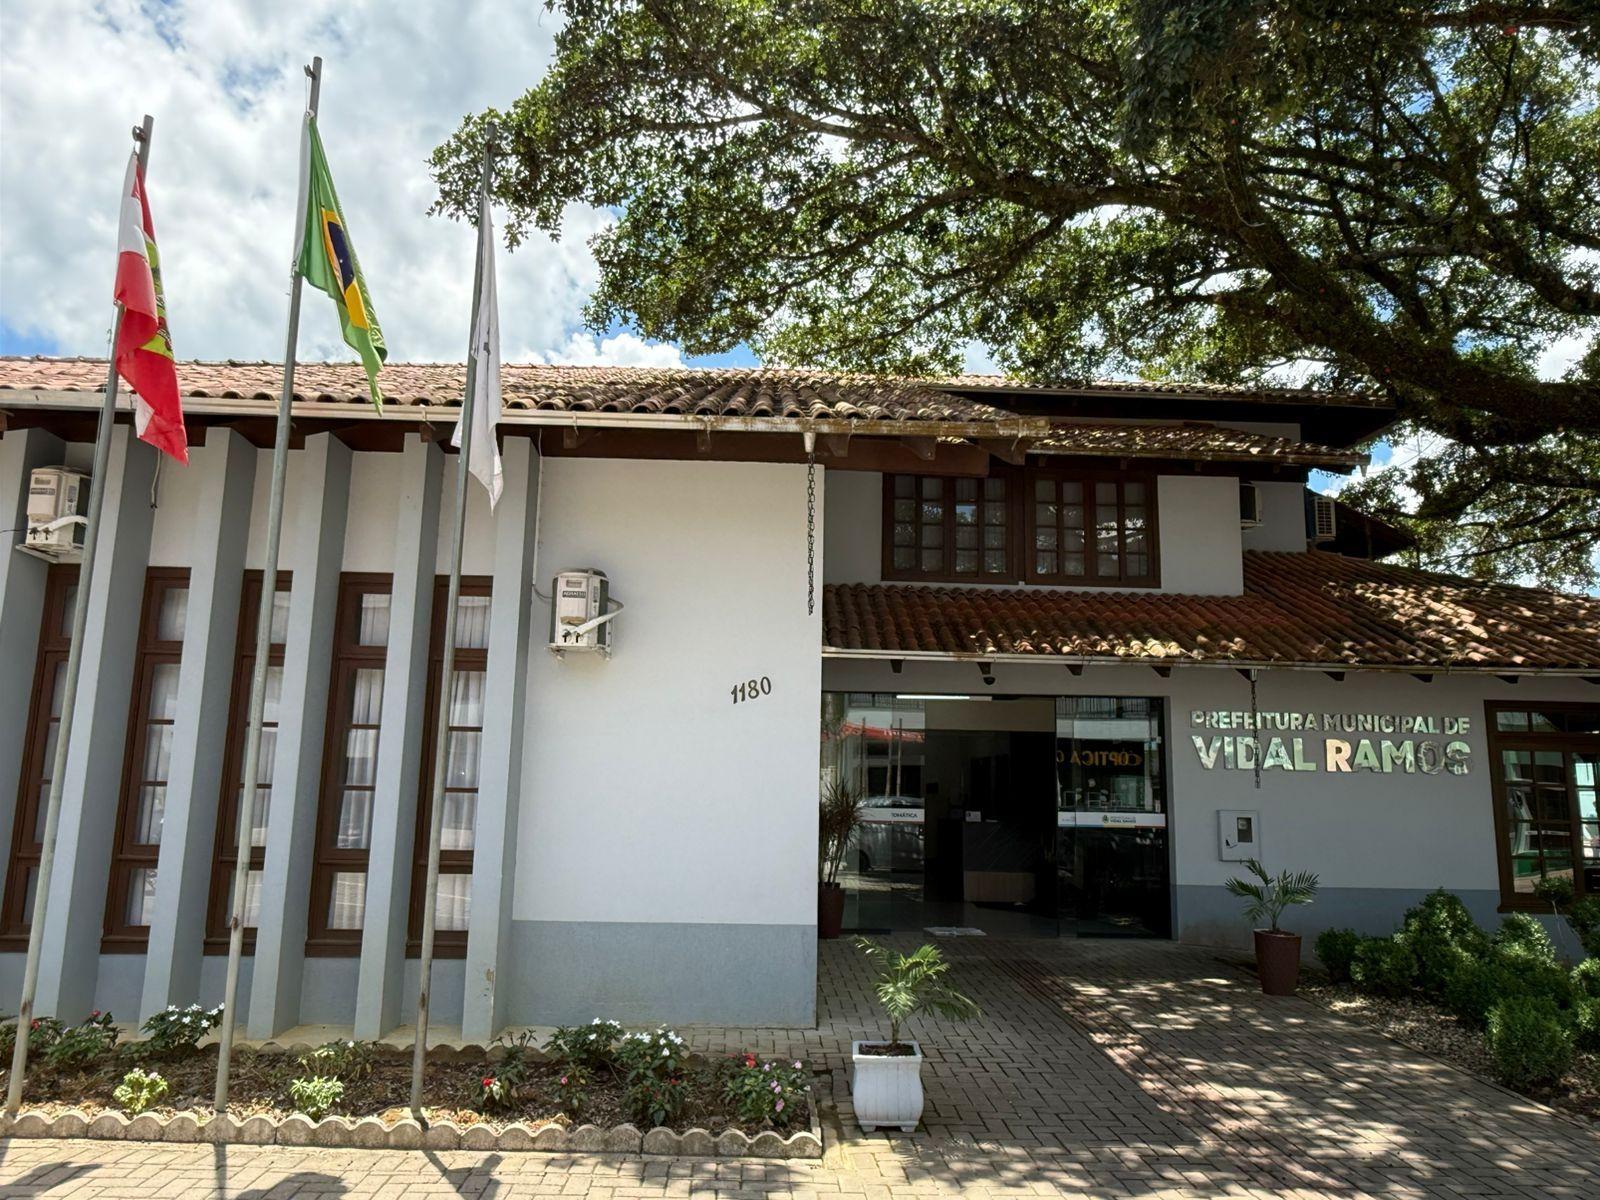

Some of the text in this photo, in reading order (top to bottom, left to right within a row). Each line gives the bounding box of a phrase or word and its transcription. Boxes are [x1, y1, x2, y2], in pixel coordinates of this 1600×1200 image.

[731, 676, 772, 704] 1180
[1190, 710, 1471, 735] PREFEITURA MUNICIPAL DE
[1192, 735, 1473, 775] VIDAL RAMOS
